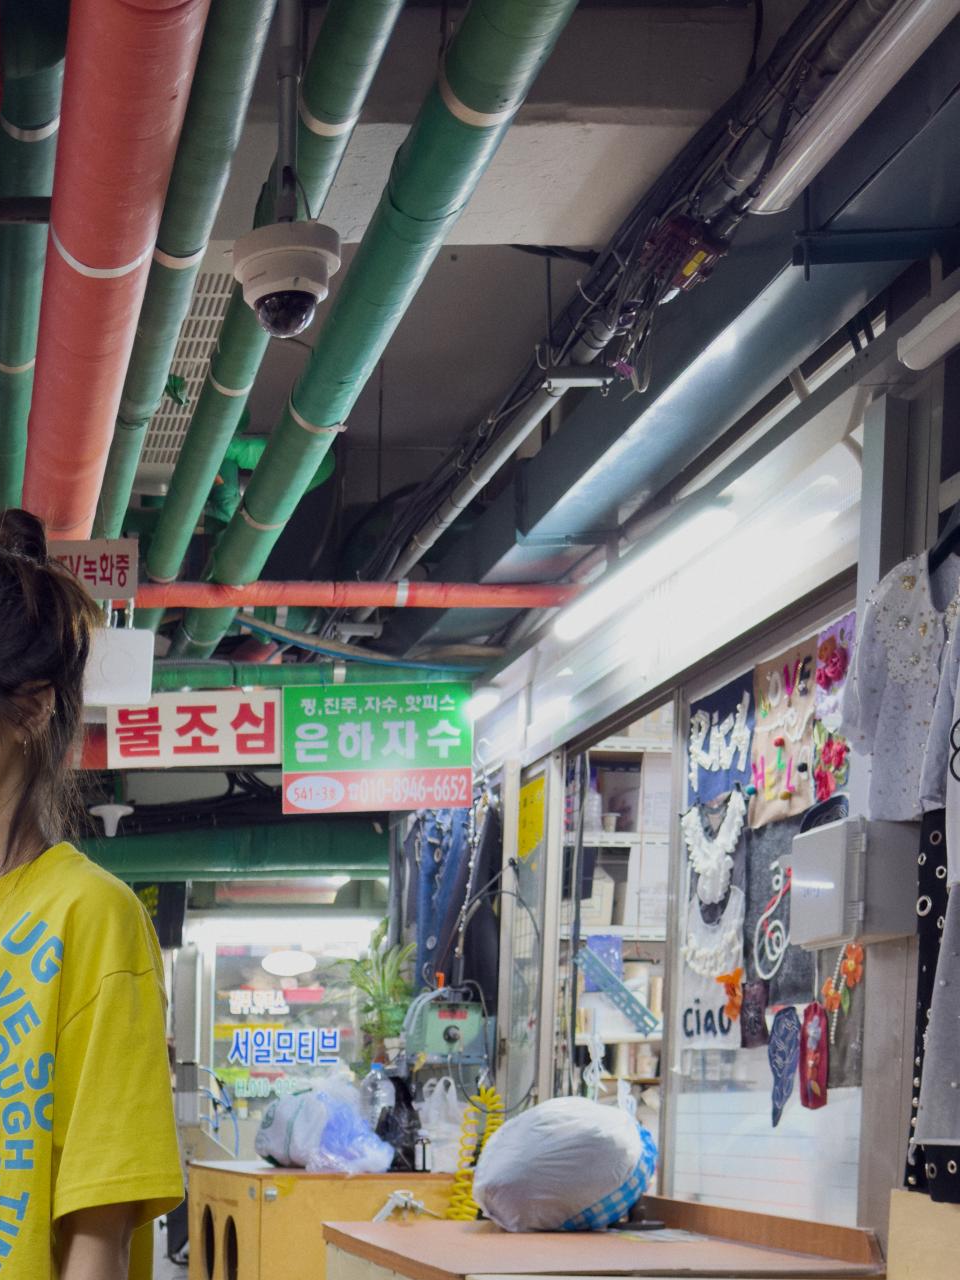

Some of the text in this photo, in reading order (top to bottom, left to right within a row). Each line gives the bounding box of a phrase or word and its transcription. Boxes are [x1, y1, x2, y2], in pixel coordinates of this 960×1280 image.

[115, 702, 276, 758] 불조심
[294, 719, 462, 763] 은하자수
[360, 774, 467, 803] 010-8946-6652
[229, 1029, 339, 1066] 서일모티브
